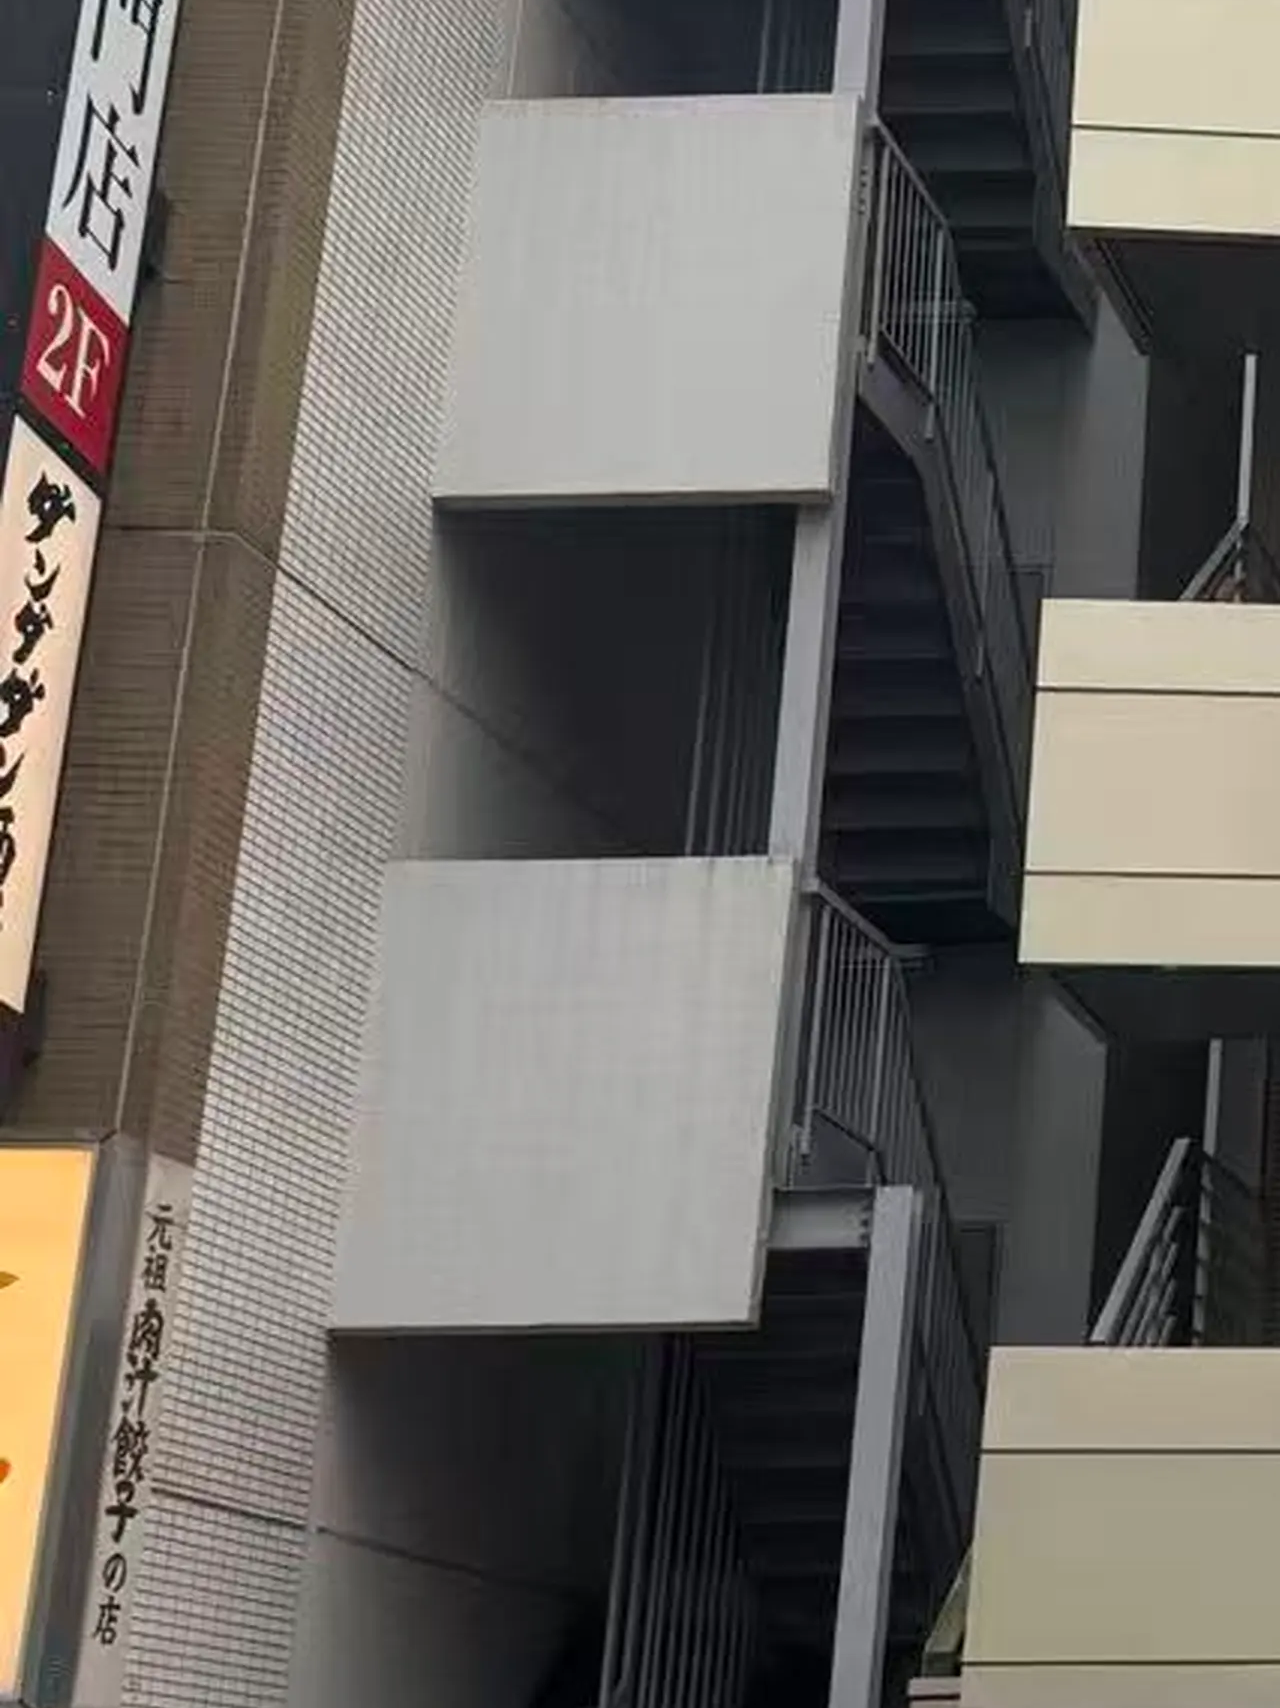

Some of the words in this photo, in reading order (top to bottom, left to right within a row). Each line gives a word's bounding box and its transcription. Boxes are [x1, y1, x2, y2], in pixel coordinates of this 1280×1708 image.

[35, 280, 112, 419] 2F
[92, 1203, 174, 1645] 元祖肉汁餃子の店
